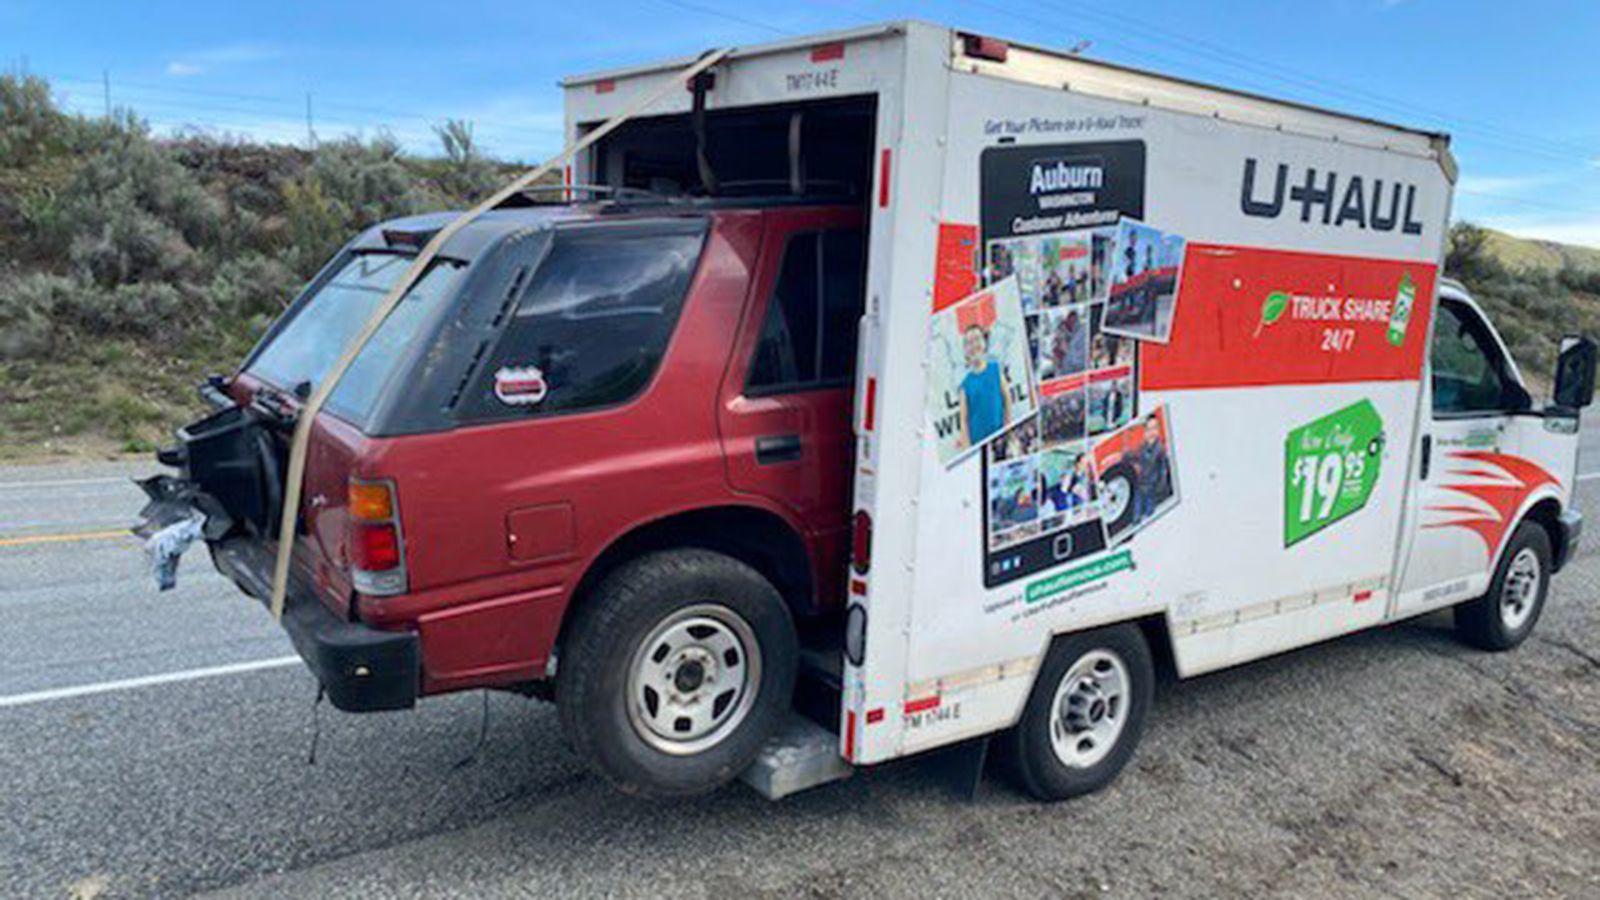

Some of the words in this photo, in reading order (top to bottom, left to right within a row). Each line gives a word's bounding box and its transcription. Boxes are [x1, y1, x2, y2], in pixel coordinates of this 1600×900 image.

[1030, 161, 1102, 194] Auburn
[1241, 158, 1422, 235] U-HAUL
[1012, 216, 1063, 233] Customer
[1292, 296, 1342, 320] TRUCK
[1344, 297, 1391, 321] SHARE
[1321, 328, 1355, 352] 24/7
